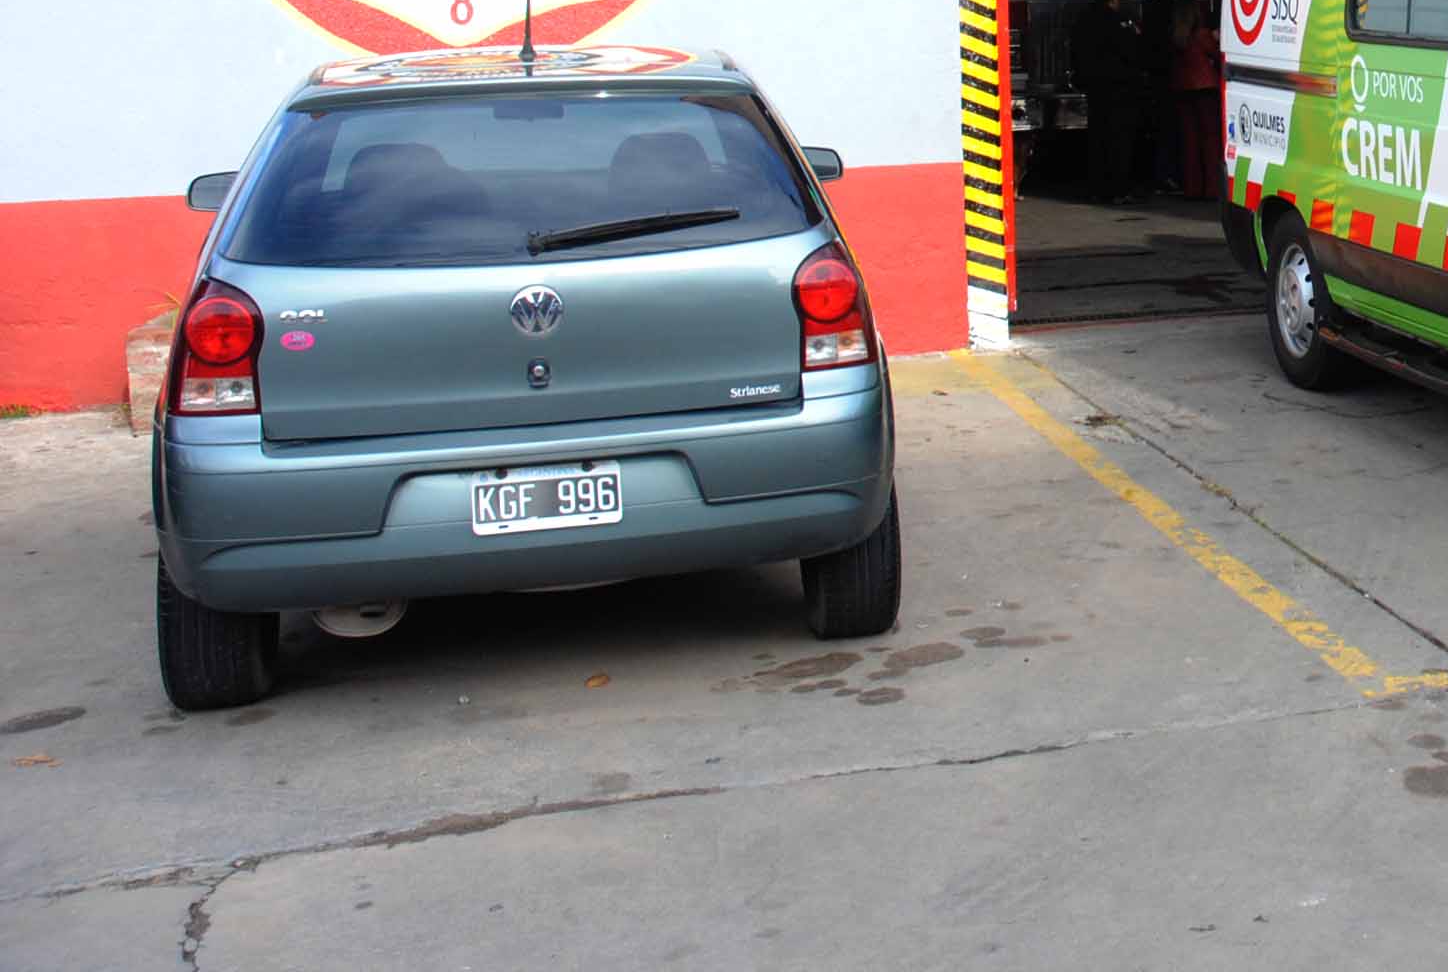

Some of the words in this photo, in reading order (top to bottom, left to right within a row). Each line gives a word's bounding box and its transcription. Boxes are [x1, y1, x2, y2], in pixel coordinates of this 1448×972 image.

[1373, 71, 1397, 99] POR
[1399, 75, 1424, 103] VOS
[1253, 110, 1285, 133] QUILMES
[1342, 117, 1422, 191] CREM
[479, 484, 536, 522] KGF
[558, 477, 615, 514] 996
